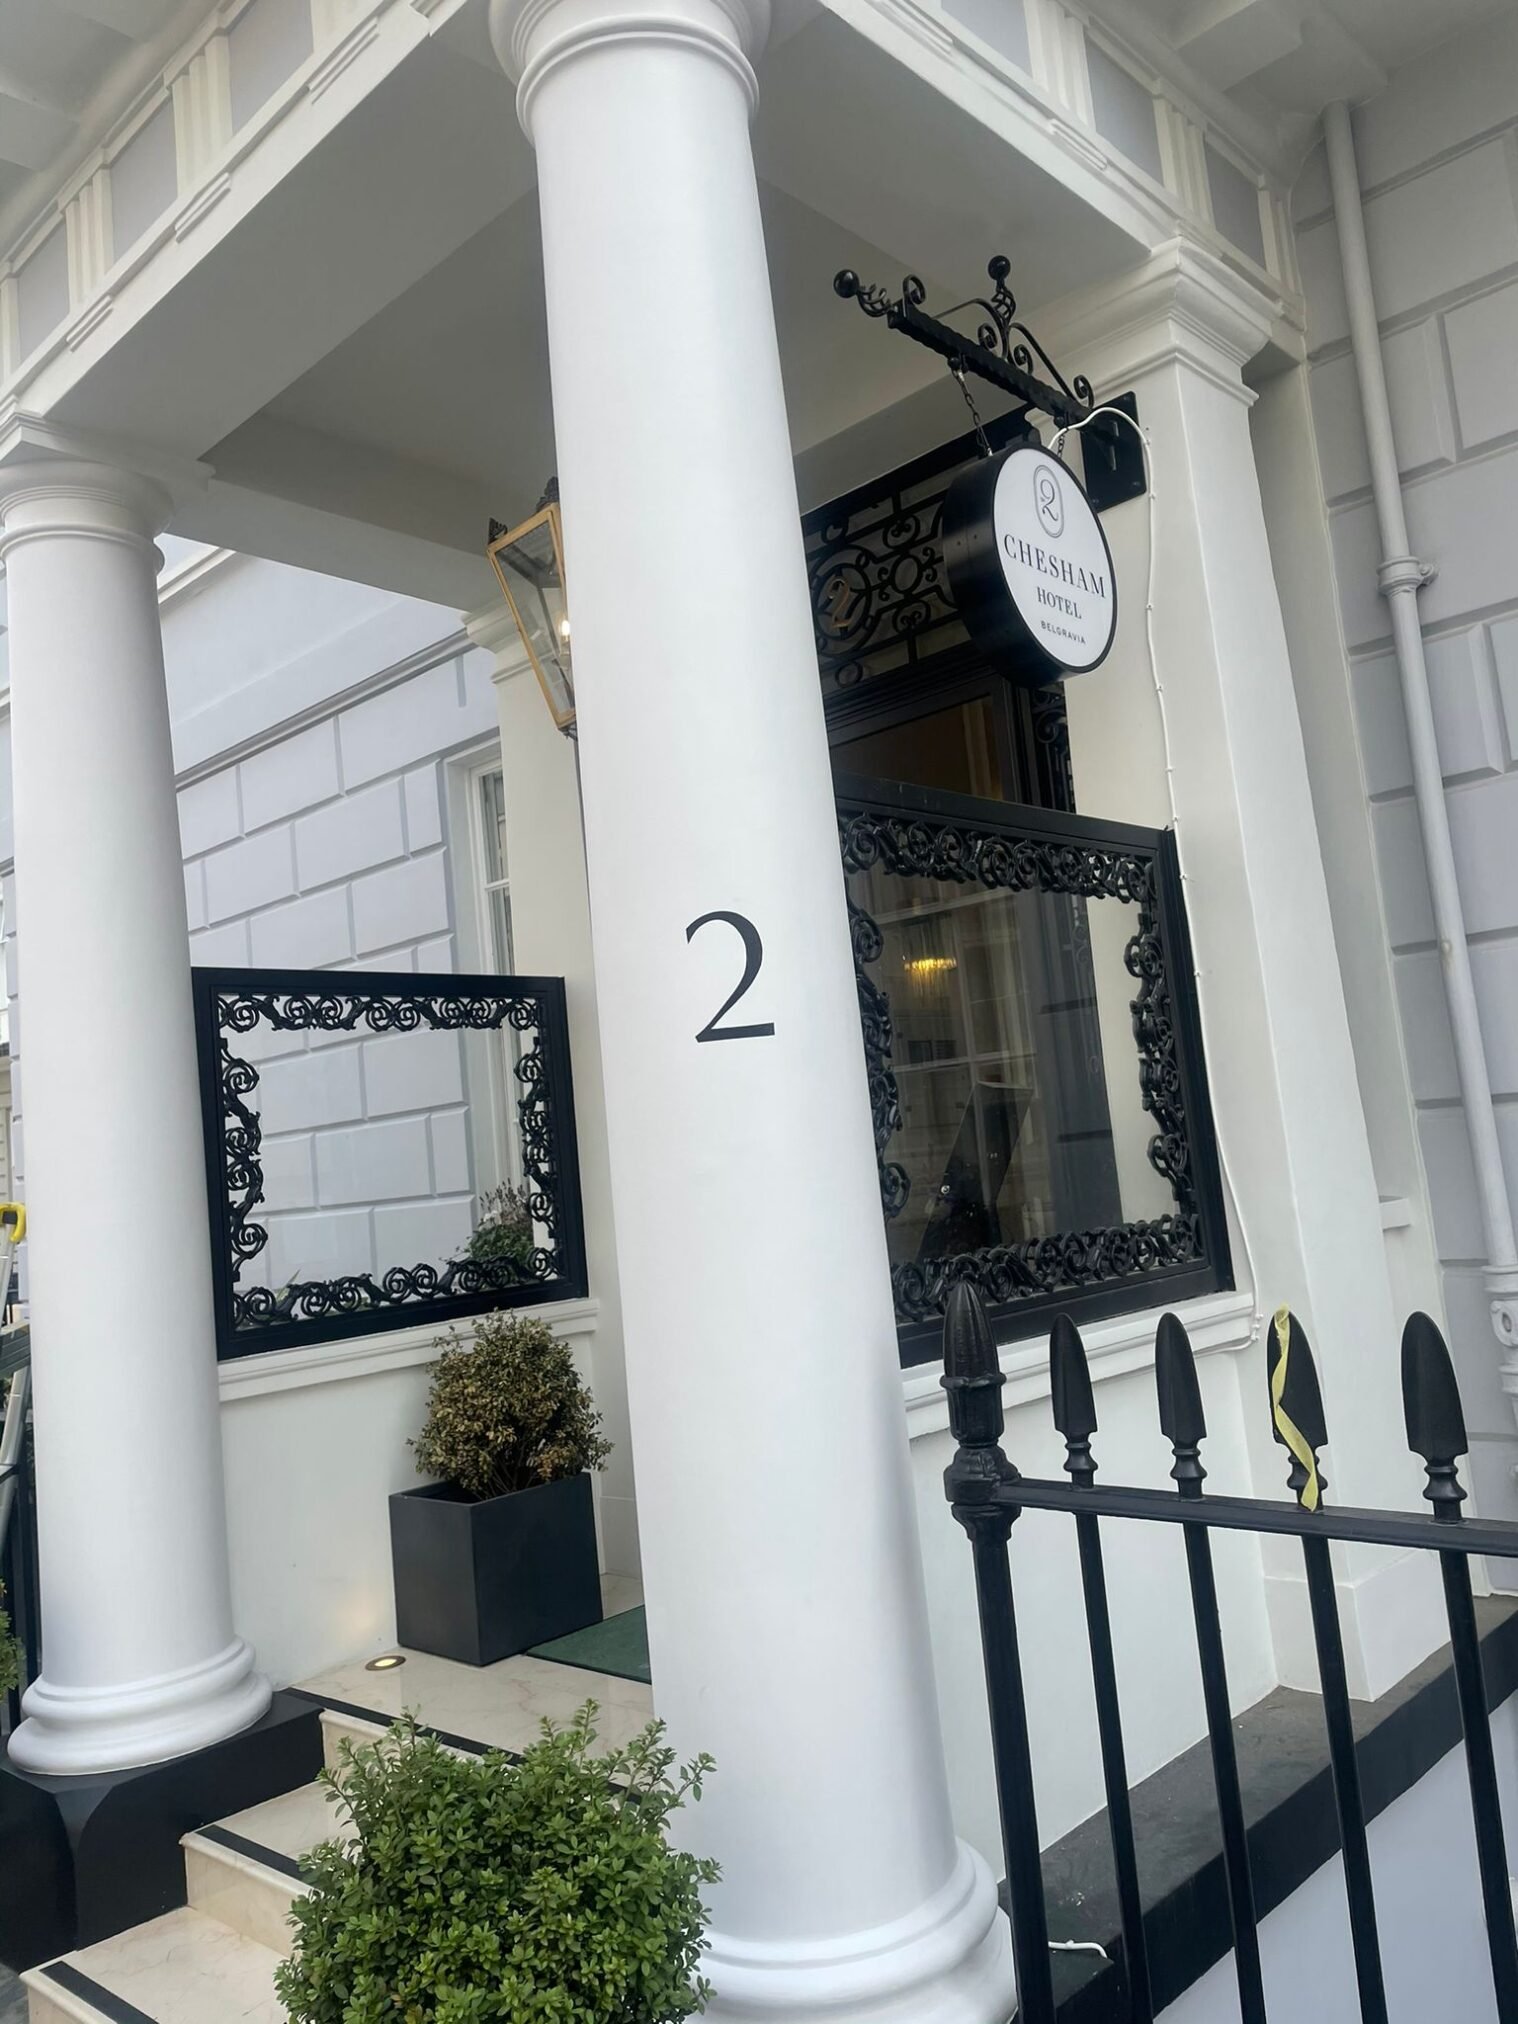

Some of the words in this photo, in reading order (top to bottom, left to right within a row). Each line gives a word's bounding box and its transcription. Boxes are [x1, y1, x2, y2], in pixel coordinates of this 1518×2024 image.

[1040, 479, 1059, 522] 2
[1004, 534, 1106, 599] CHESHAM
[1037, 586, 1082, 620] HOTEL
[1040, 620, 1086, 645] BELGRAVIA
[686, 911, 775, 1043] 2
